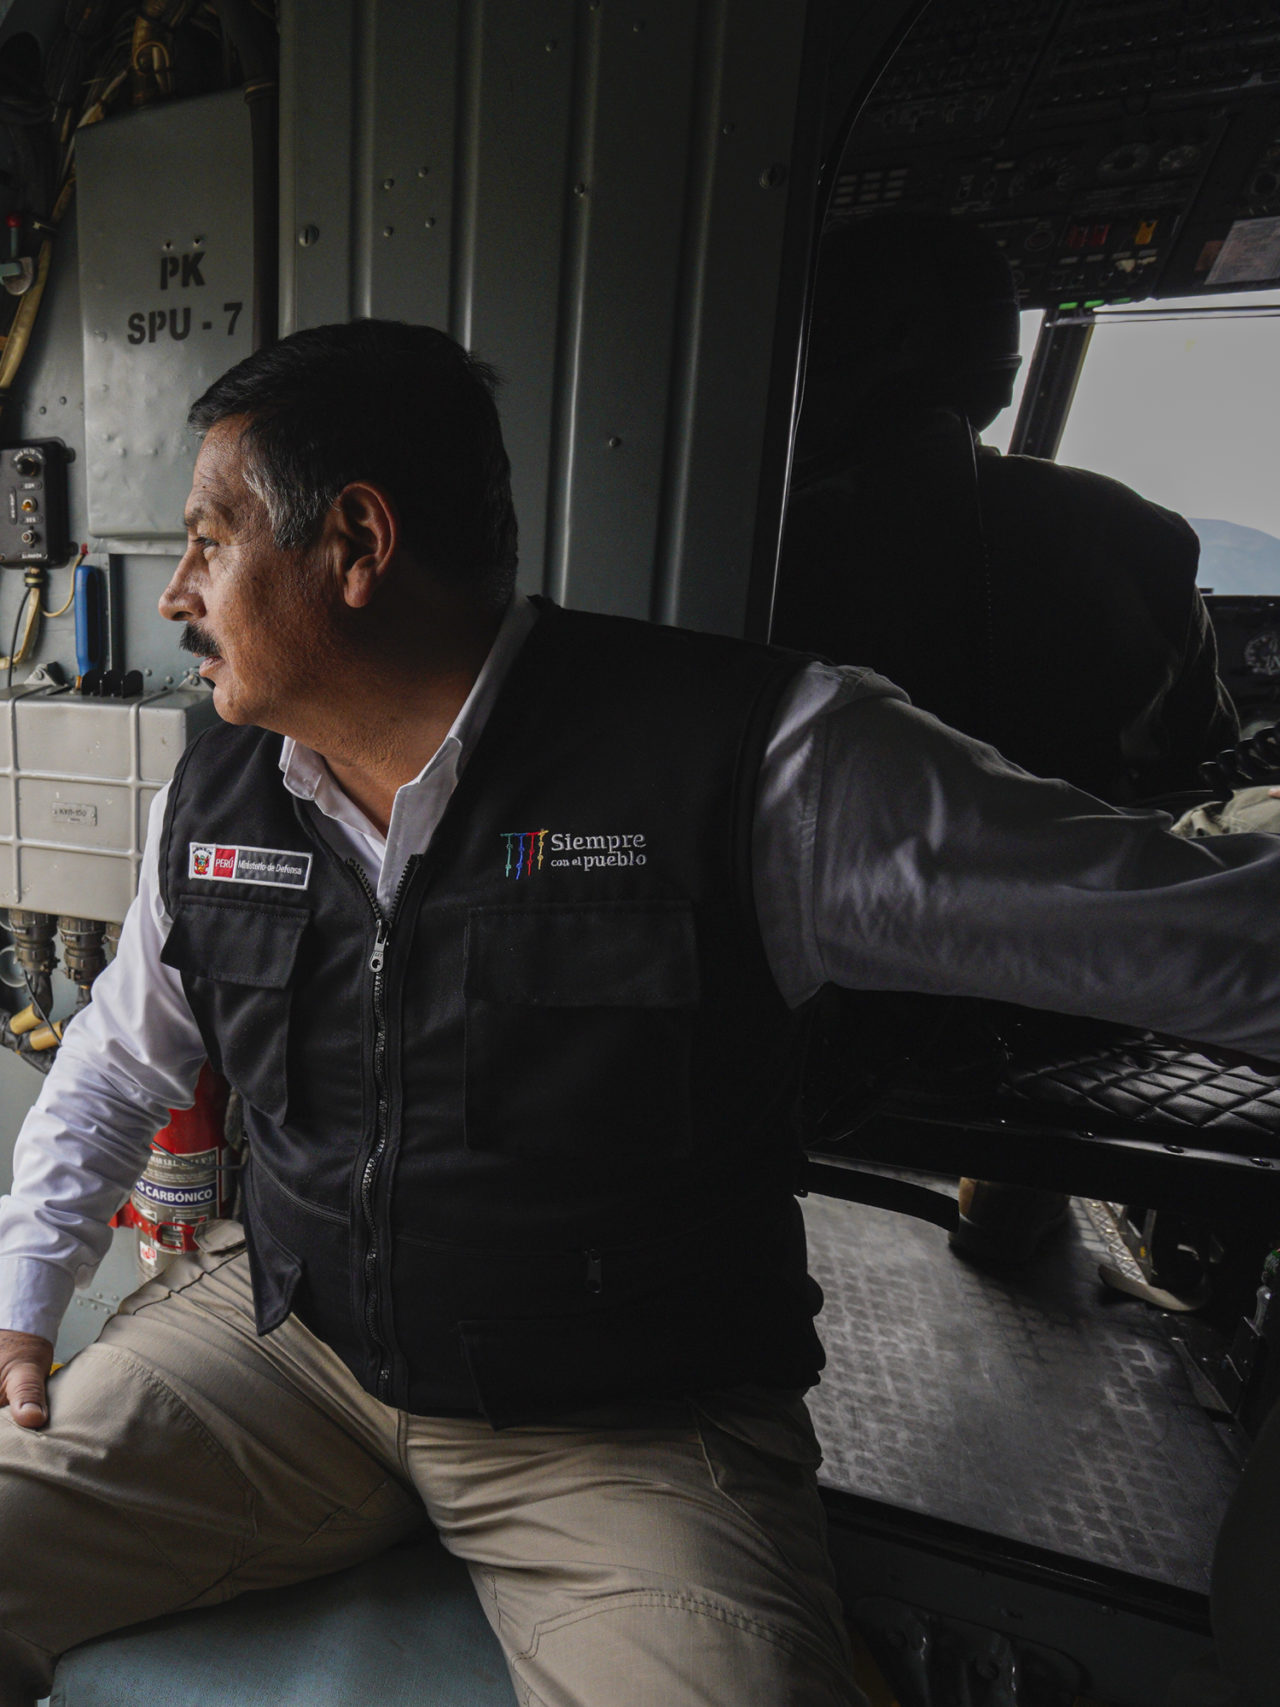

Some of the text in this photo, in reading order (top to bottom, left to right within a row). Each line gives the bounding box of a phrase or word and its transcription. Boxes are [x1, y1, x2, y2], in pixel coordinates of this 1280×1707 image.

[160, 252, 205, 290] PK
[551, 833, 646, 853] Siempre
[215, 856, 234, 868] PERÚ
[551, 851, 647, 871] con el pueblo
[146, 1186, 213, 1203] CARBÓNICO
